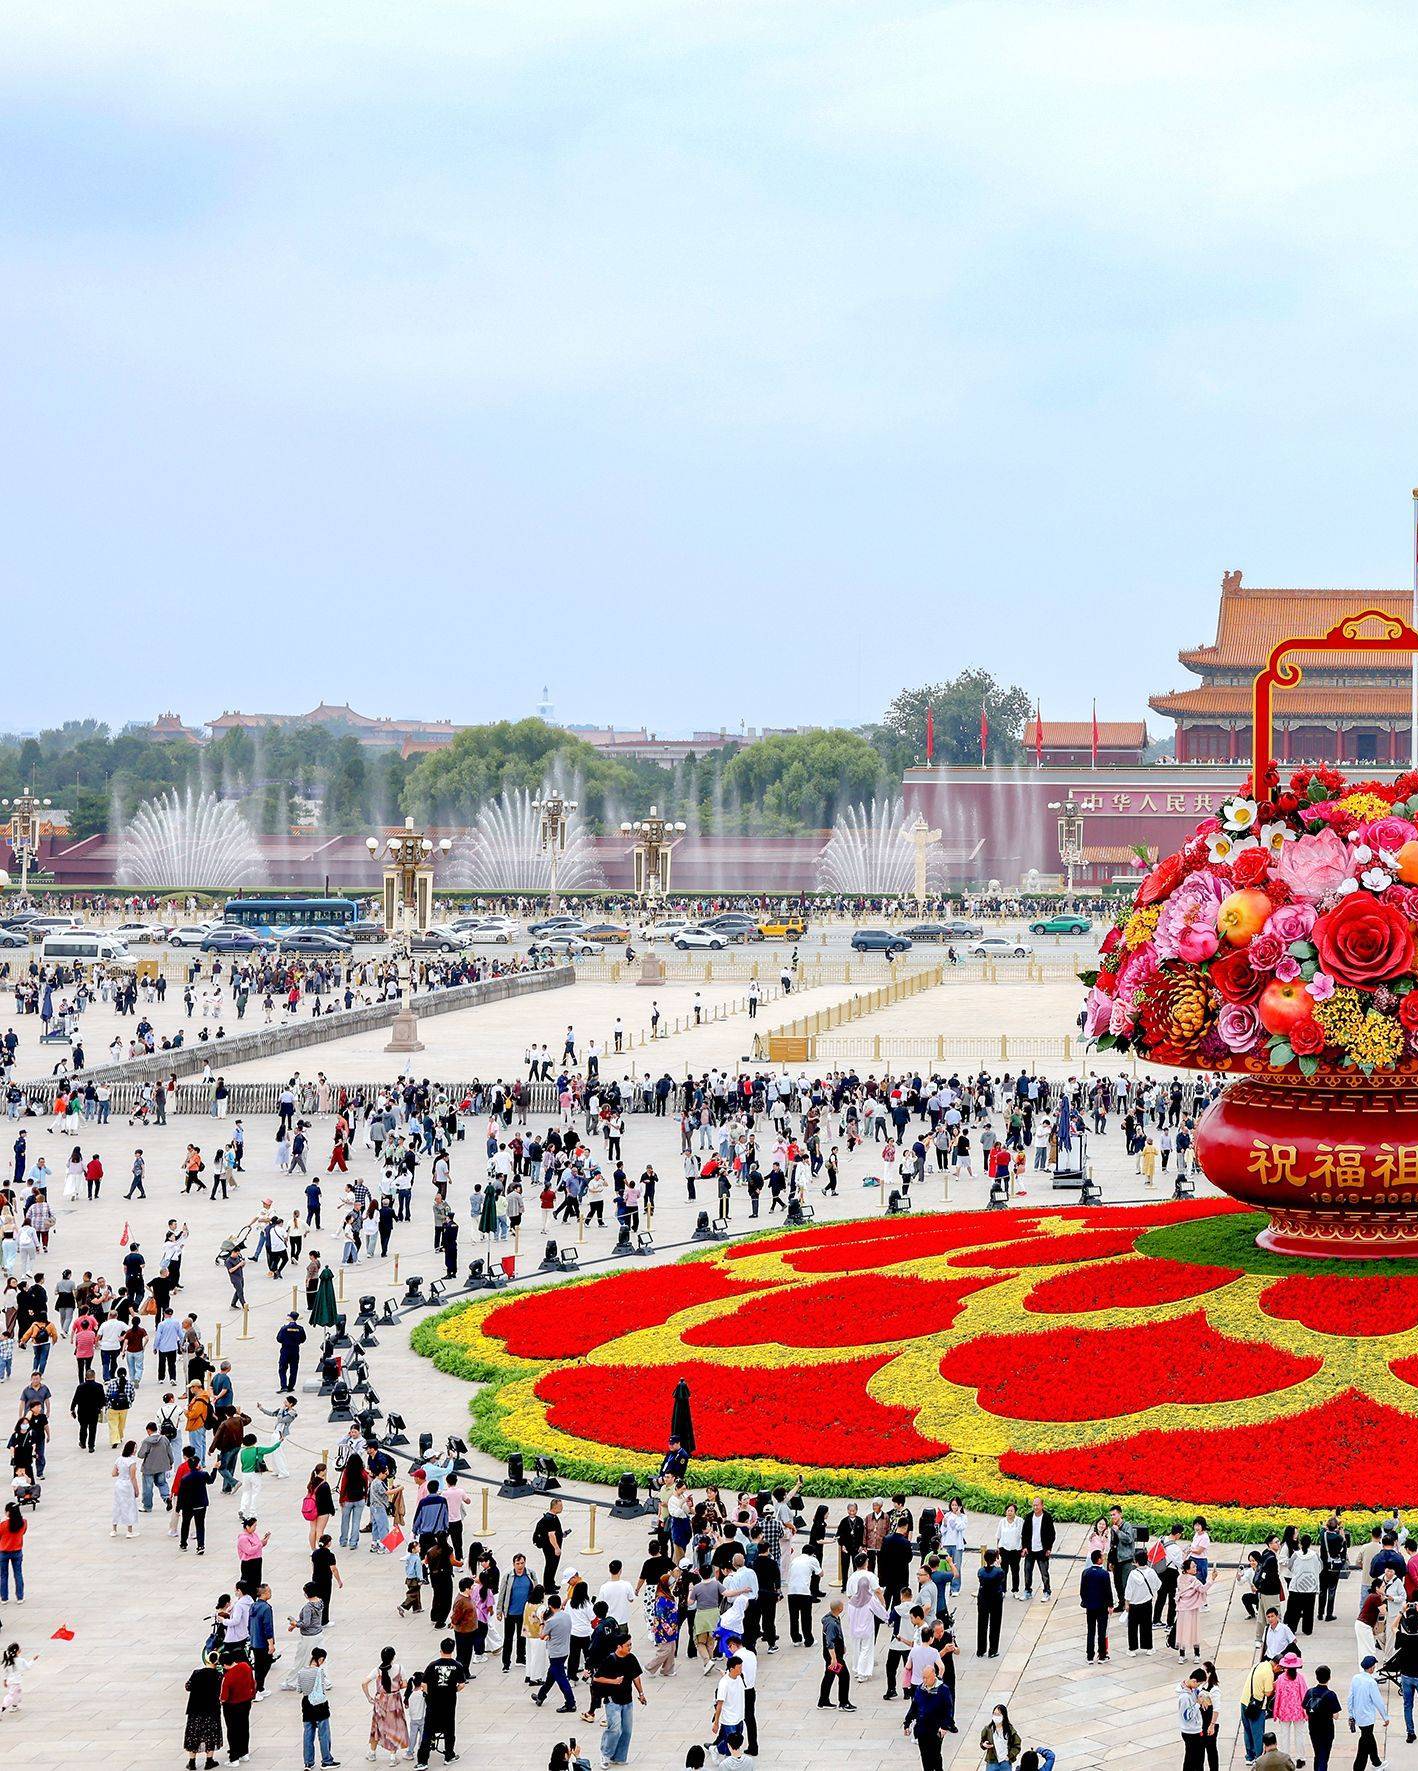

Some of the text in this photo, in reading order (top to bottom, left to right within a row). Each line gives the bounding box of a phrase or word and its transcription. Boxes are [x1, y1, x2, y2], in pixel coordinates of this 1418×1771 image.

[1083, 793, 1234, 813] 中华人民共
